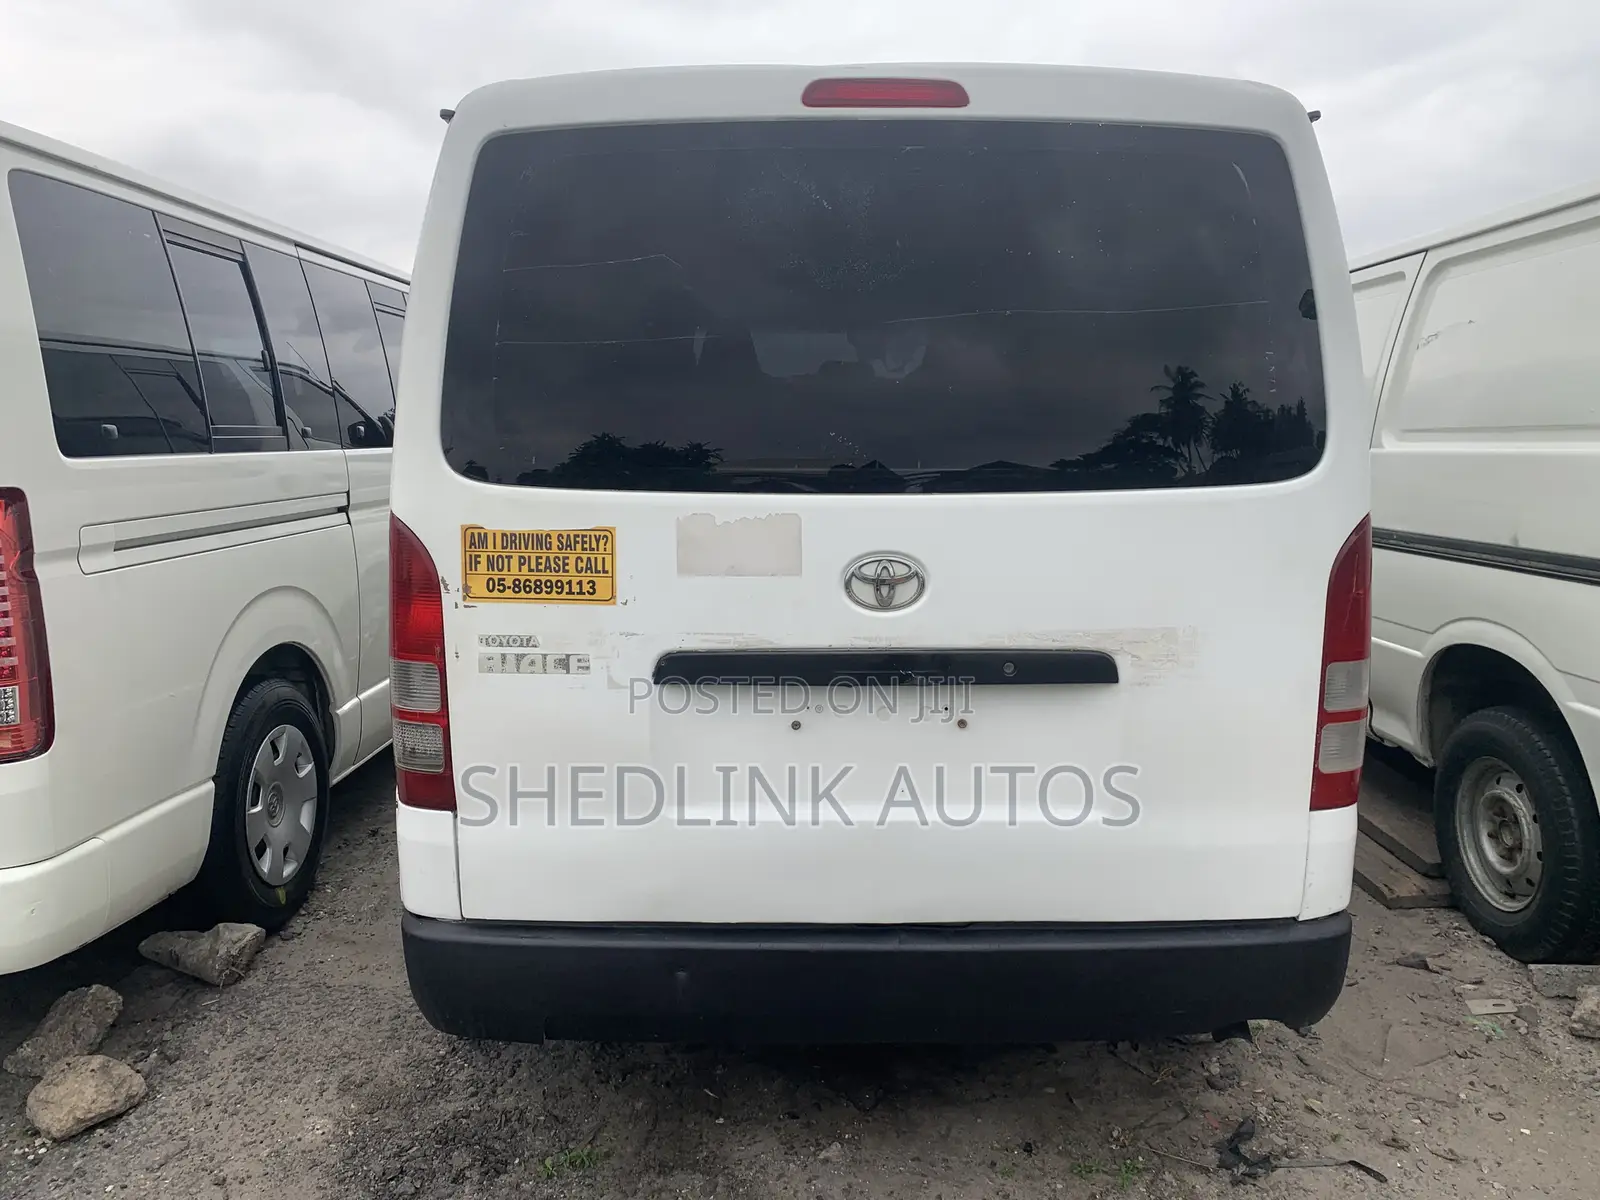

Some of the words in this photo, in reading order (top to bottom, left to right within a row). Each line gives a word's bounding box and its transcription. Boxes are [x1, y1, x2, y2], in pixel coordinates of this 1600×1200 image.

[469, 532, 488, 550] AM
[492, 532, 497, 550] I
[501, 533, 552, 551] DRIVING
[557, 533, 609, 552] SAFELY?
[469, 554, 481, 572] IF
[487, 554, 513, 572] NOT
[518, 555, 570, 573] PLEASE
[575, 556, 609, 574] CALL
[486, 577, 597, 596] 05-86899113
[478, 634, 540, 648] TOYOTA
